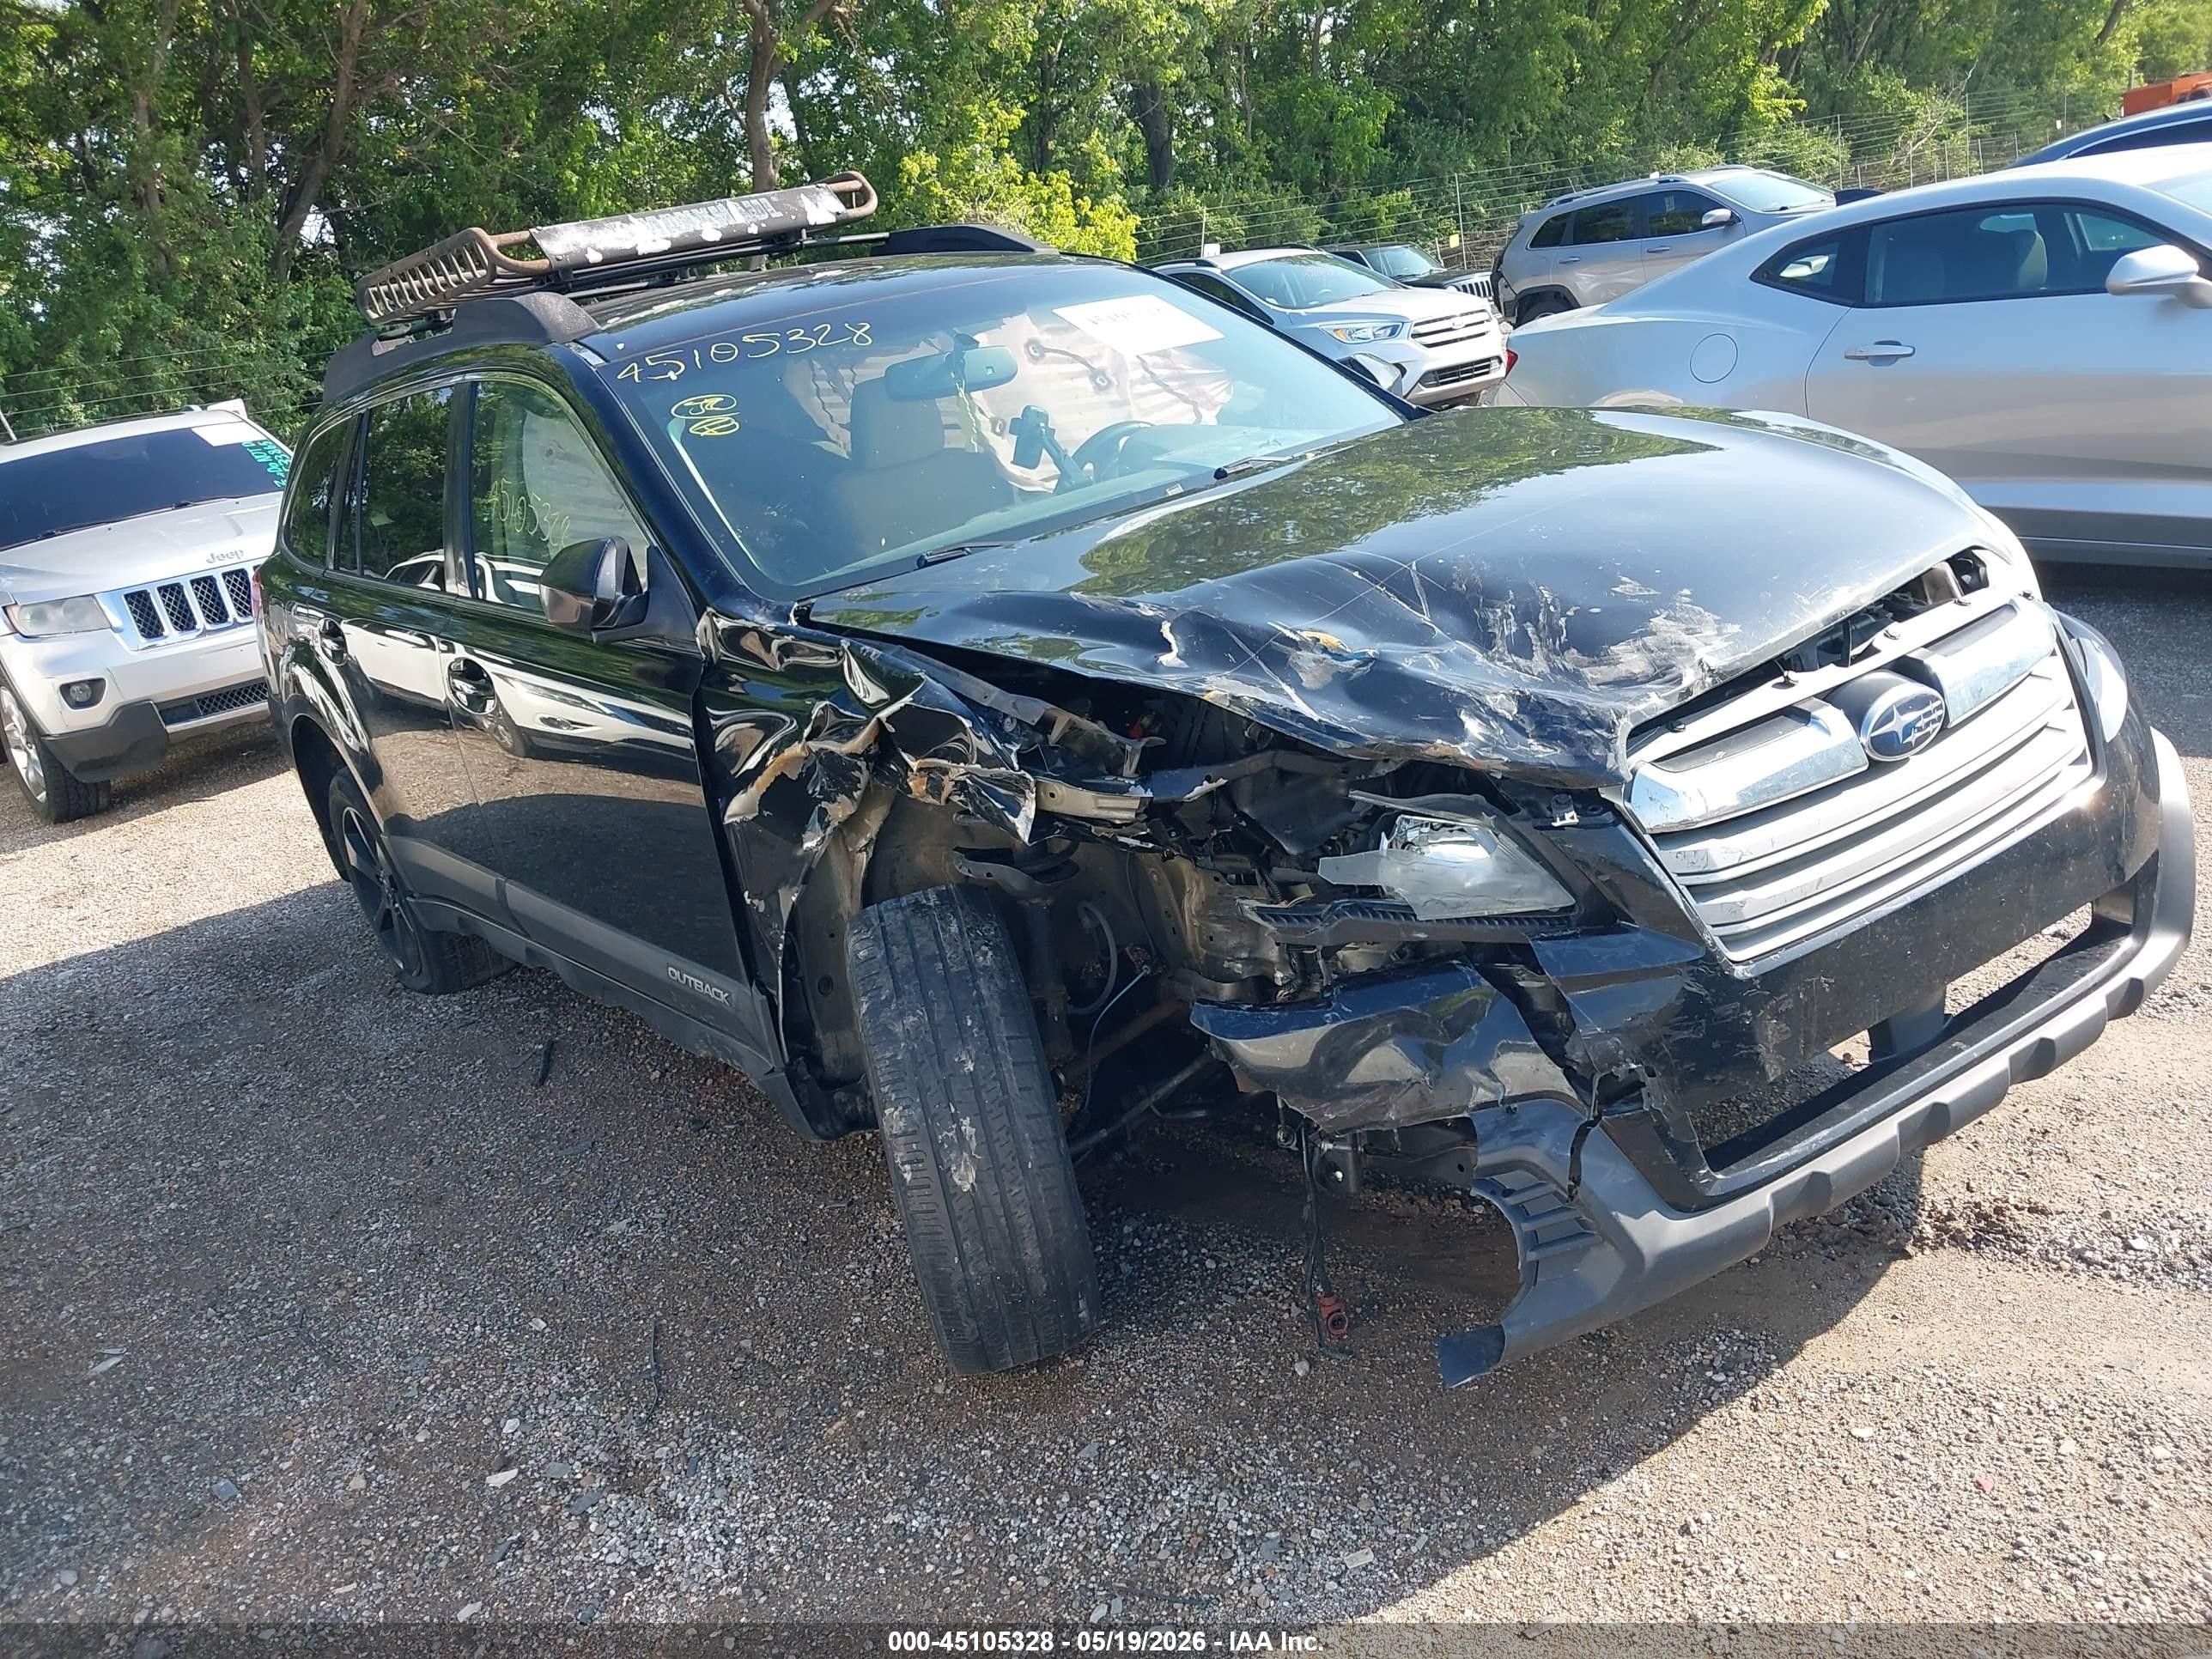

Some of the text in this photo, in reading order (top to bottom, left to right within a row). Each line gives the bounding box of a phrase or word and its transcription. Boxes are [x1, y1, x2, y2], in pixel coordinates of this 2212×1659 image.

[617, 322, 873, 383] 45105328
[205, 550, 245, 563] Jeep
[667, 966, 731, 1007] OUTBACK
